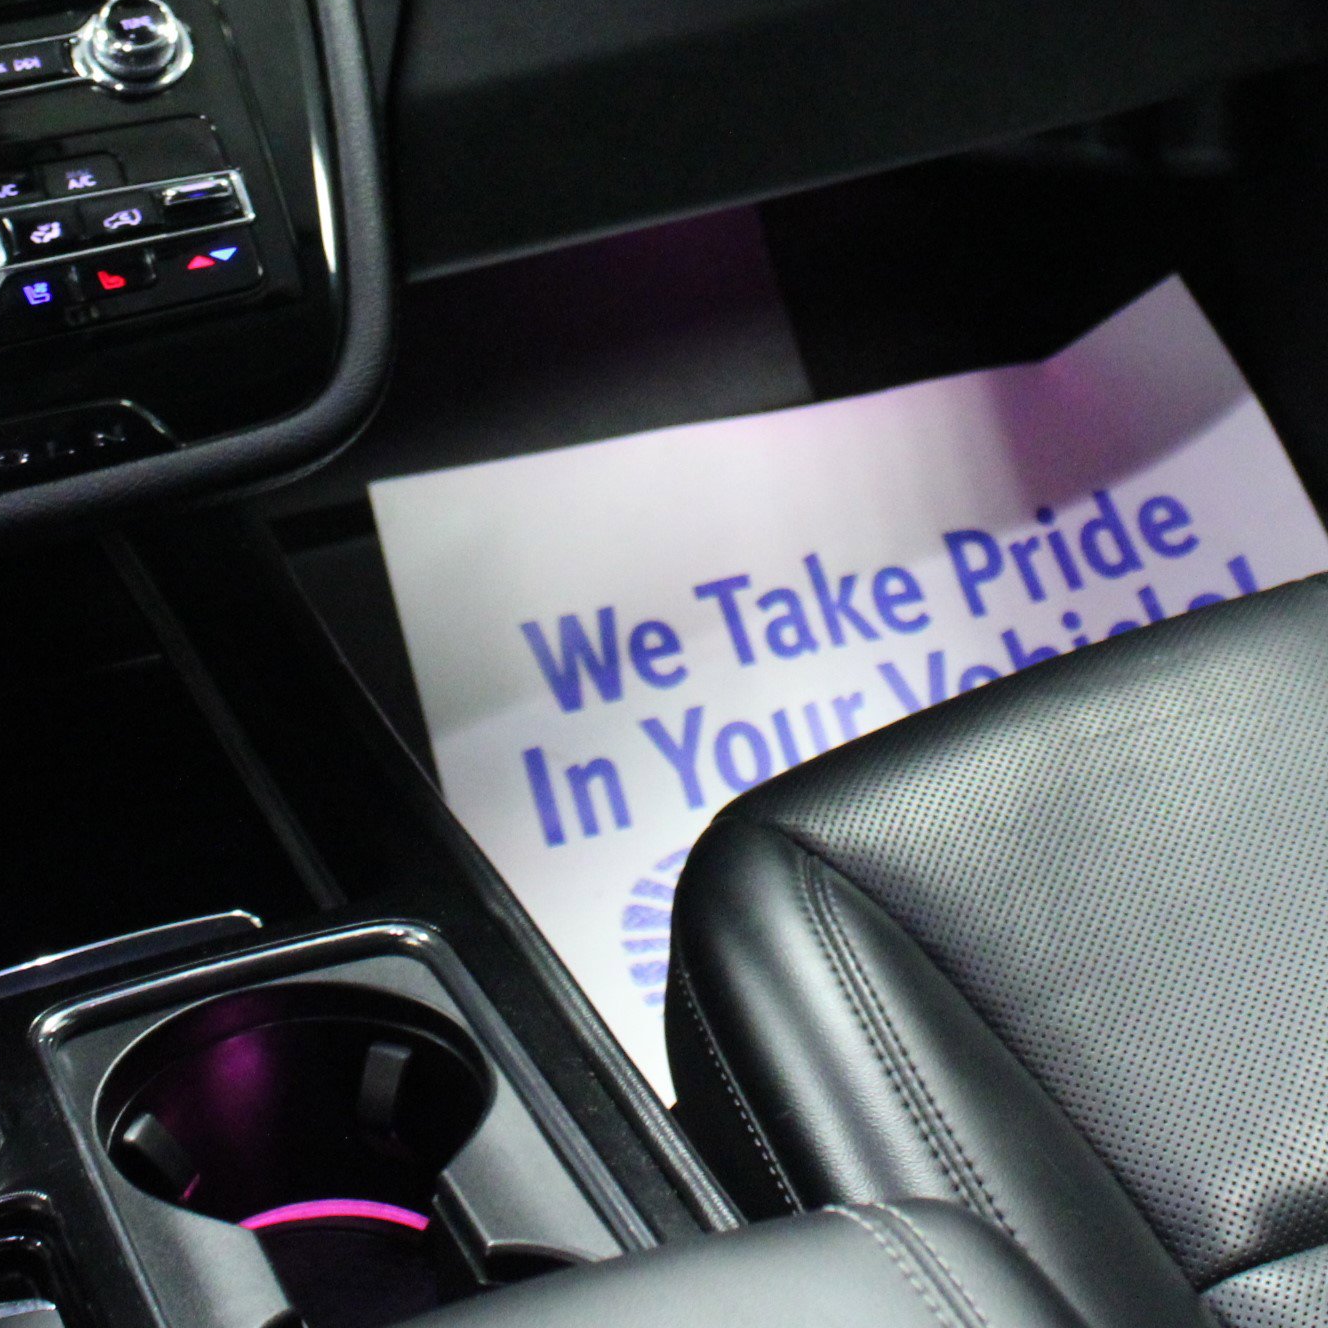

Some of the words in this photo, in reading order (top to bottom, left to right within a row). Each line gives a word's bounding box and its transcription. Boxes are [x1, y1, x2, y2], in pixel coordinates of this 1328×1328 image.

[521, 606, 689, 715] We
[693, 553, 932, 668] Take
[942, 488, 1202, 620] Pride
[522, 746, 632, 849] In
